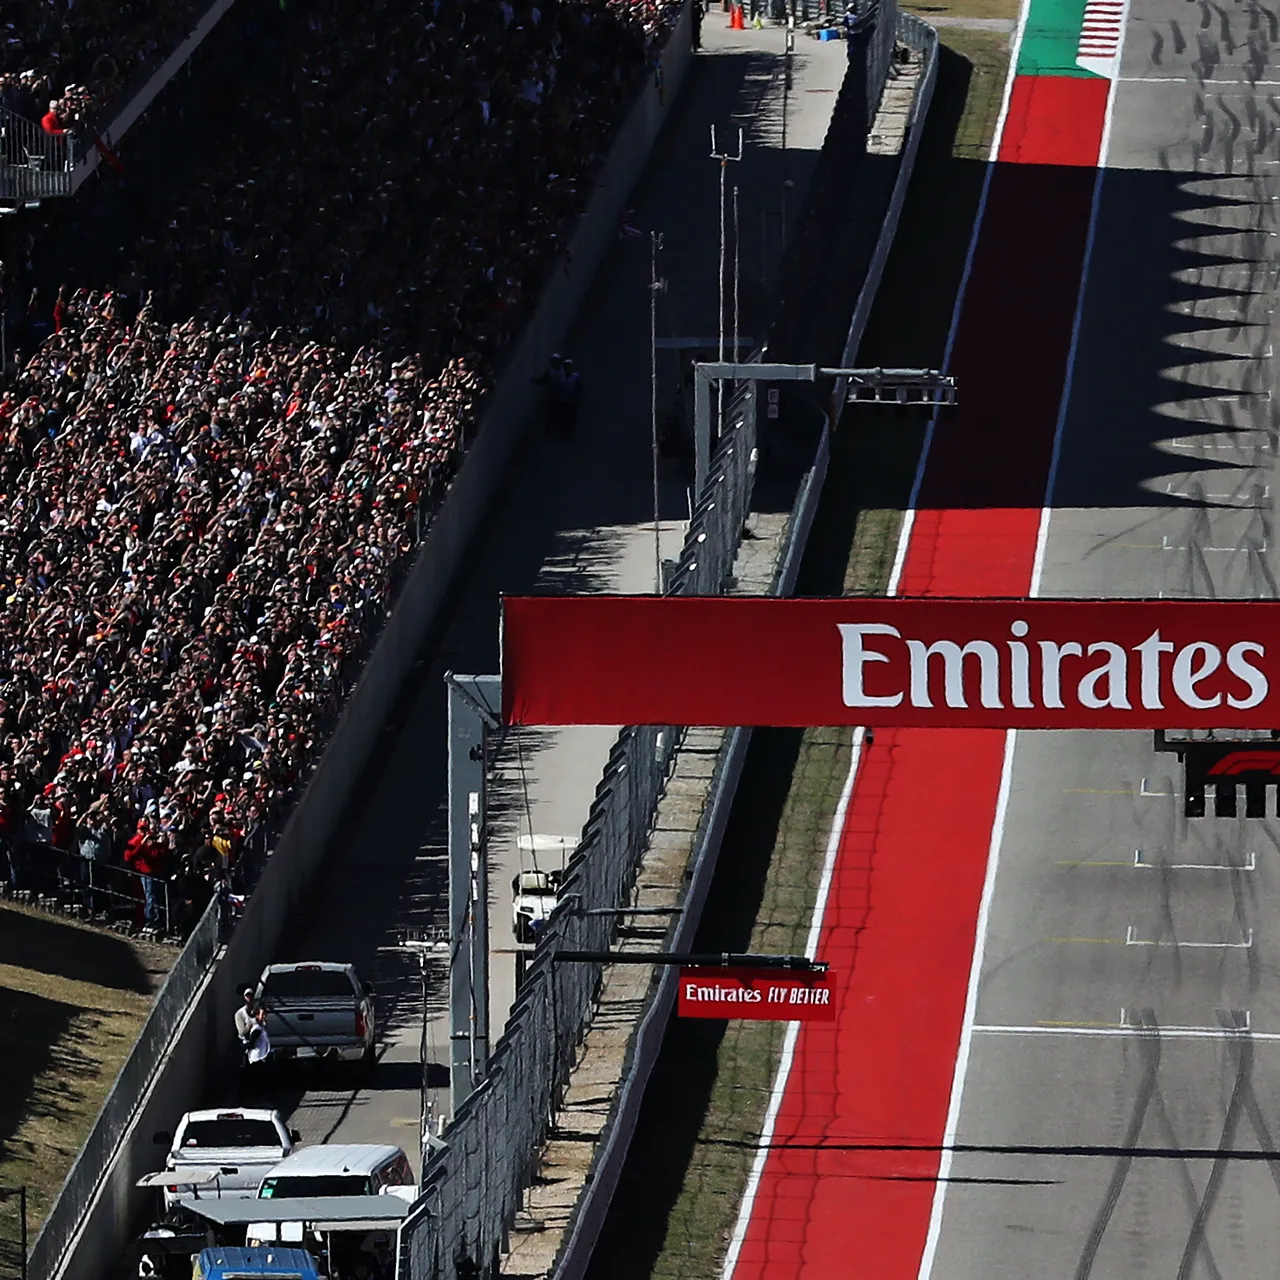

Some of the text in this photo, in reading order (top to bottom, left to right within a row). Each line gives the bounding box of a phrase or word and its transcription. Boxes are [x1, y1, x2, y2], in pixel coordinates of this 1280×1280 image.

[838, 620, 1268, 710] Emirates
[685, 984, 830, 1005] Emirates FLY BETTER
